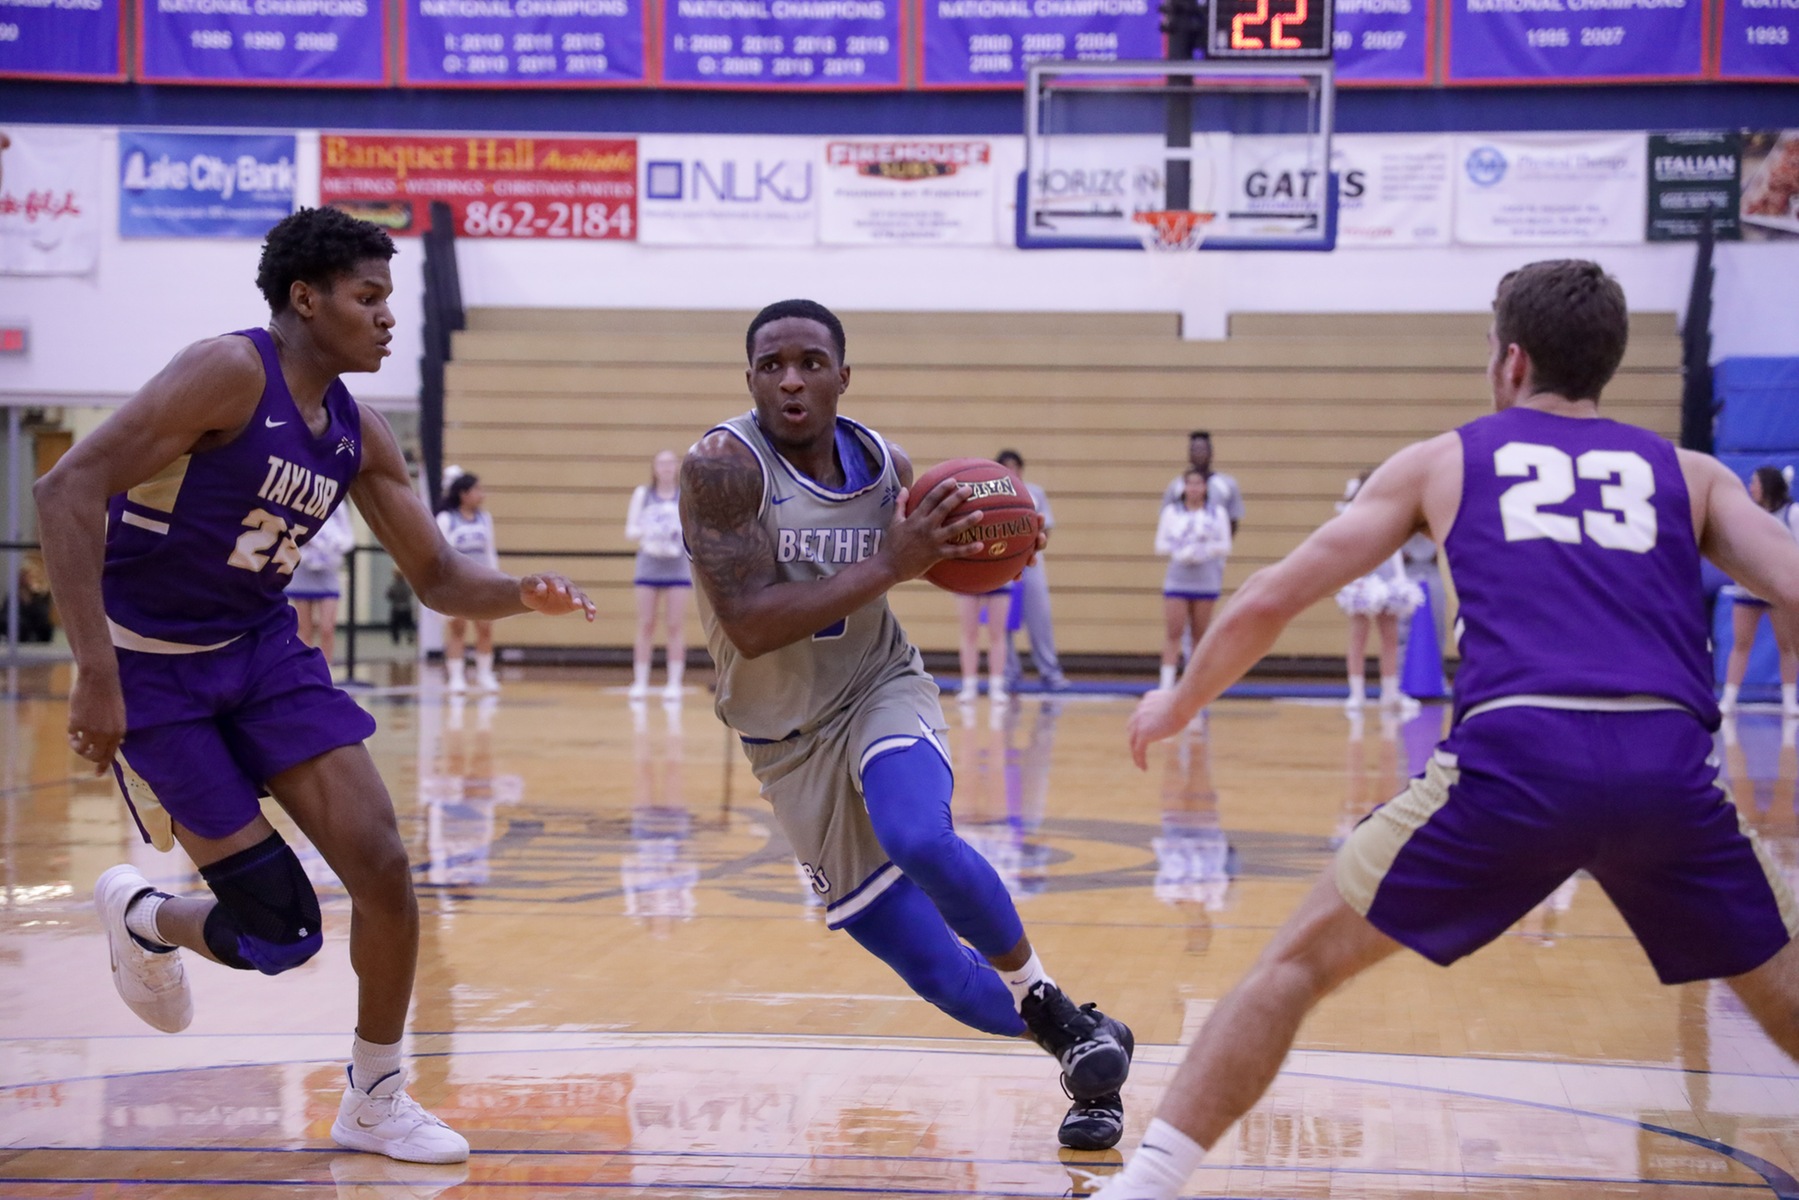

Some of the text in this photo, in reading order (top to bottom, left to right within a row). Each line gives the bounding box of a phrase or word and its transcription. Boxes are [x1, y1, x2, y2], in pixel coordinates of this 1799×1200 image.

[420, 0, 628, 17] NATIONAL CHAMPIONS
[678, 1, 886, 19] NATIONAL CHAMPIONS
[938, 0, 1148, 18] NATIONAL CHAMPIONS
[1232, 0, 1308, 49] 22
[1580, 26, 1626, 46] 2007
[1362, 31, 1406, 50] 2007
[325, 137, 456, 179] Banquet
[467, 139, 535, 171] Hall
[827, 141, 991, 165] FIREHOUSE
[1654, 154, 1736, 175] ITALIAN
[124, 151, 295, 200] Lake City Bank
[691, 160, 813, 203] NLKJ
[1245, 170, 1366, 199] GATS
[464, 201, 633, 237] 862-2184
[257, 455, 338, 520] TAYLOR
[1493, 441, 1658, 553] 23
